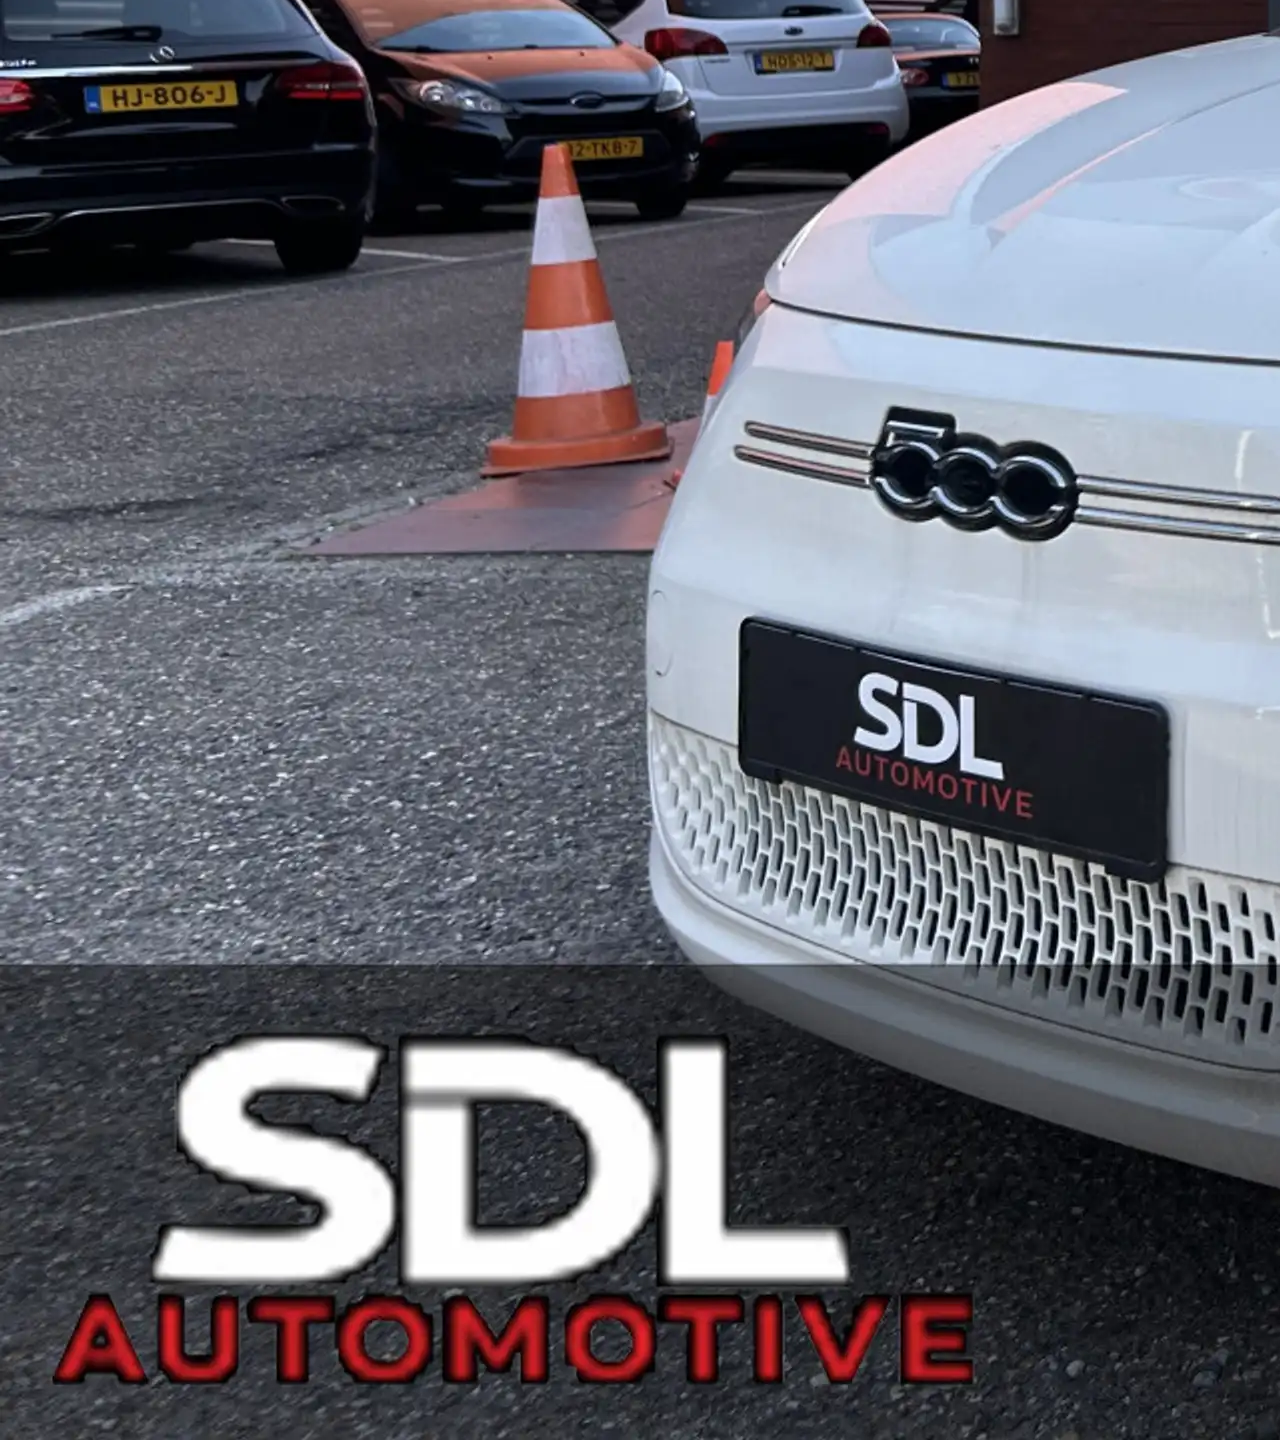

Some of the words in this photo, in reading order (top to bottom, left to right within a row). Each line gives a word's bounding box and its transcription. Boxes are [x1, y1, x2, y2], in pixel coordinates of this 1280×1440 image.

[112, 86, 226, 108] HJ-806-J
[870, 405, 1083, 542] 500
[853, 672, 1005, 780] SDL
[836, 744, 1035, 820] AUTOMOTIVE
